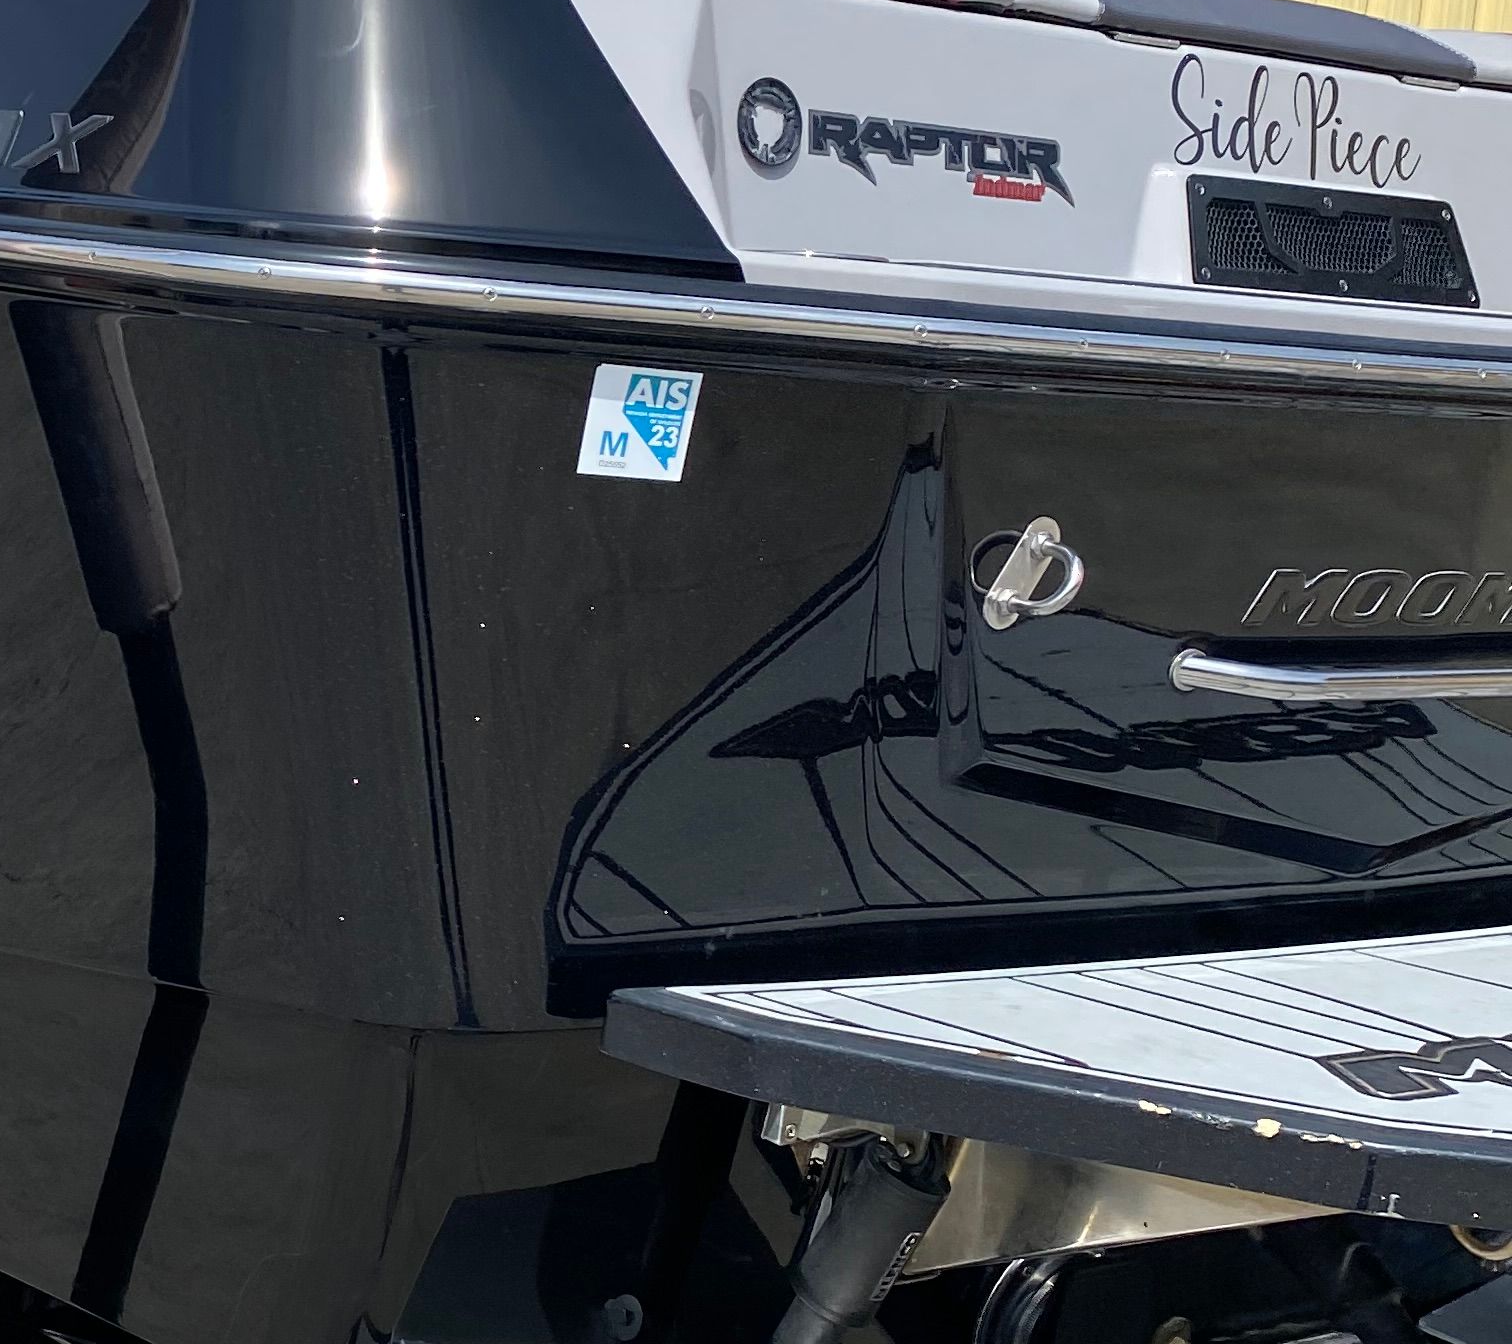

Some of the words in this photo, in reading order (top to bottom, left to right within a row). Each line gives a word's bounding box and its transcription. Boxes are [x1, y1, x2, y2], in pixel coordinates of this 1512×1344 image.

[1172, 53, 1293, 174] Side
[1294, 71, 1422, 189] Piece
[808, 109, 1076, 208] RAPTOR
[625, 378, 689, 410] AIS
[599, 430, 628, 457] M
[648, 424, 680, 449] 23
